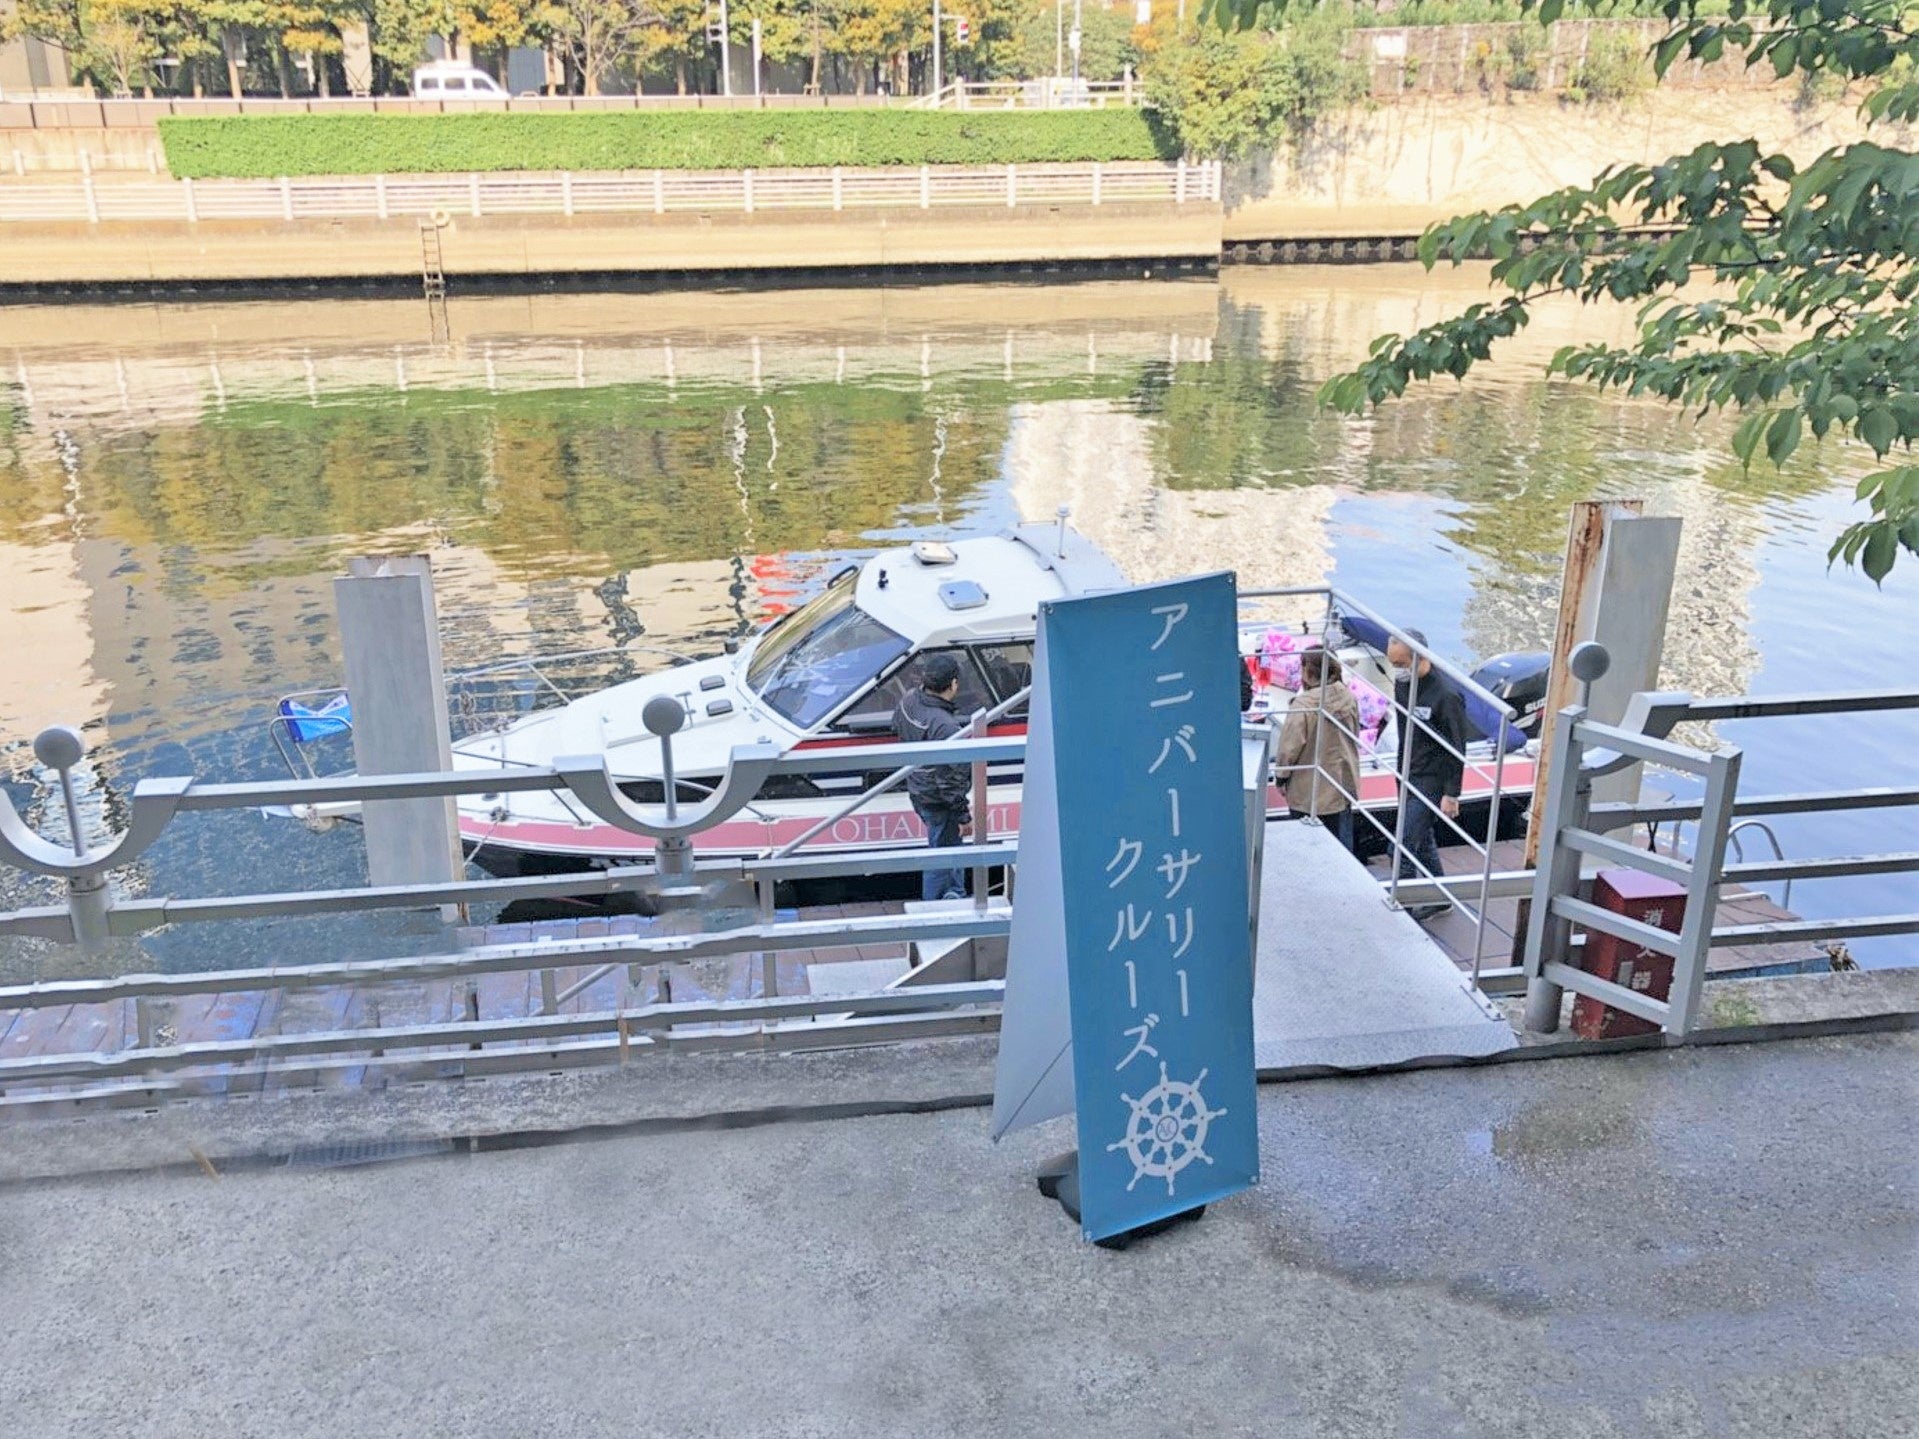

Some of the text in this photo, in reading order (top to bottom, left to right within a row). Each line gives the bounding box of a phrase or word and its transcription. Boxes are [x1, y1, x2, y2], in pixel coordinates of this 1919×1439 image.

[1105, 838, 1161, 1072] クルーズ
[1148, 602, 1202, 1016] アニバーサリー
